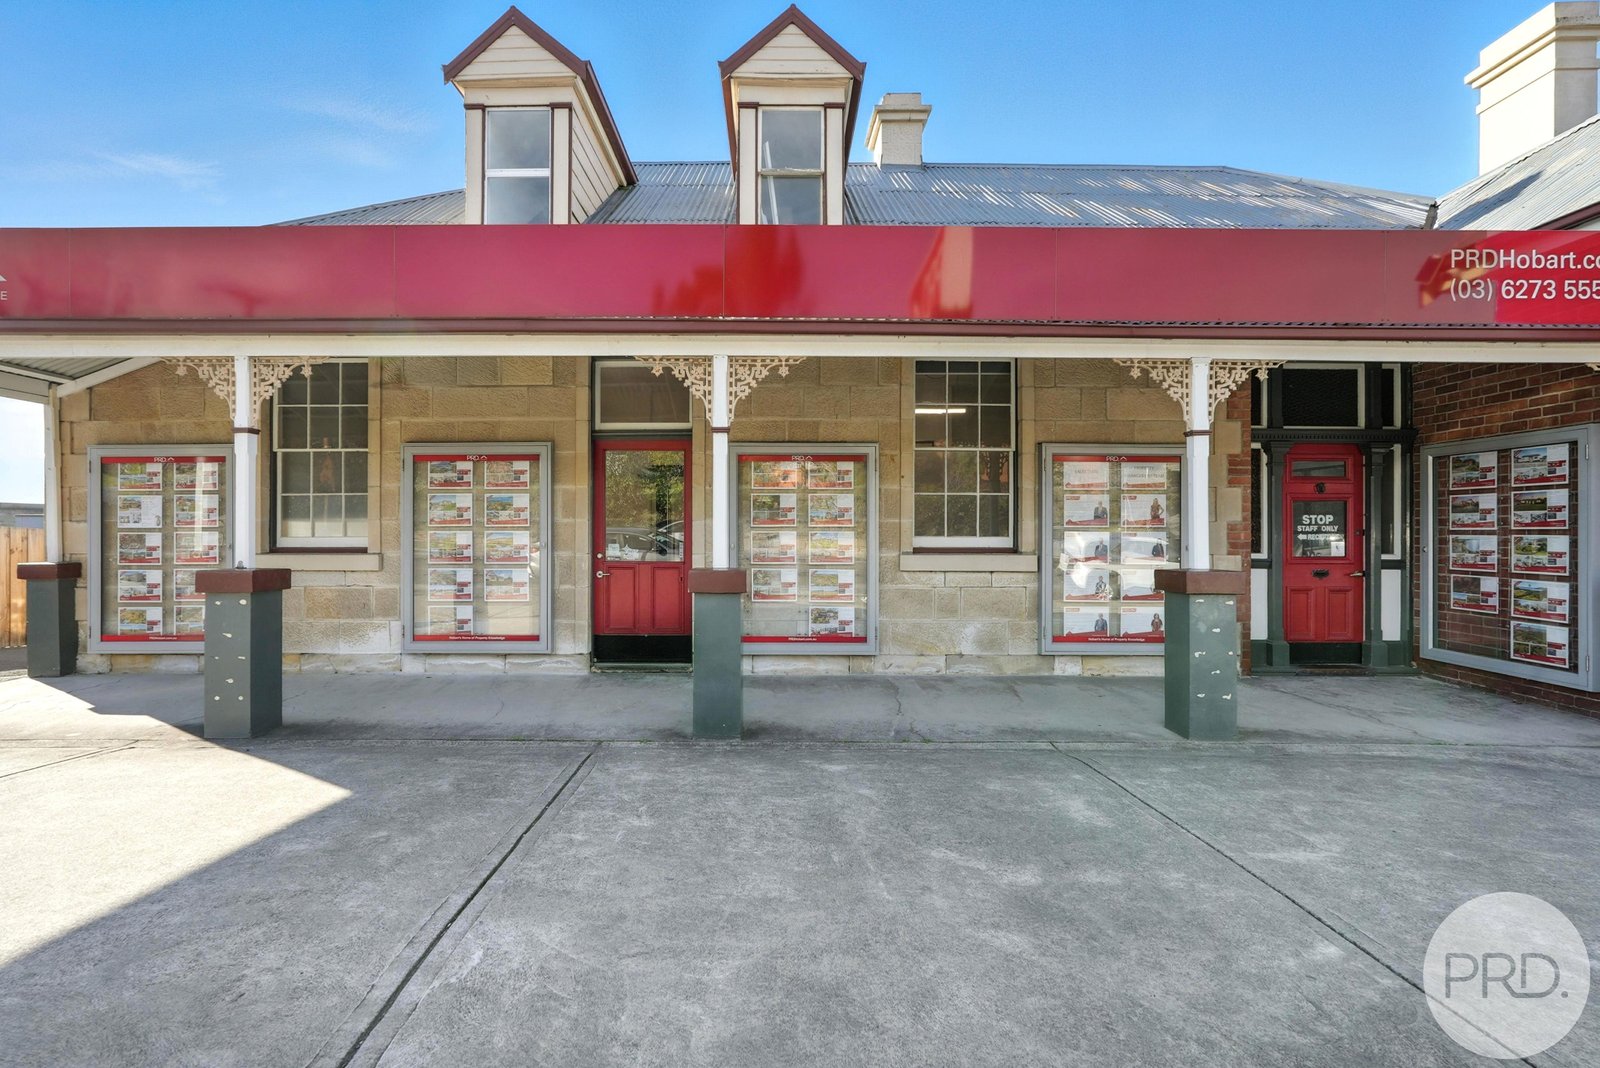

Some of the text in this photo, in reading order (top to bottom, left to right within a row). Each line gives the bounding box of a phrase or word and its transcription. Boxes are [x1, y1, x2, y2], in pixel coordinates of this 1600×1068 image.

[1, 291, 8, 300] E
[1451, 279, 1600, 301] (03) 6273 555
[1302, 514, 1334, 525] STOP
